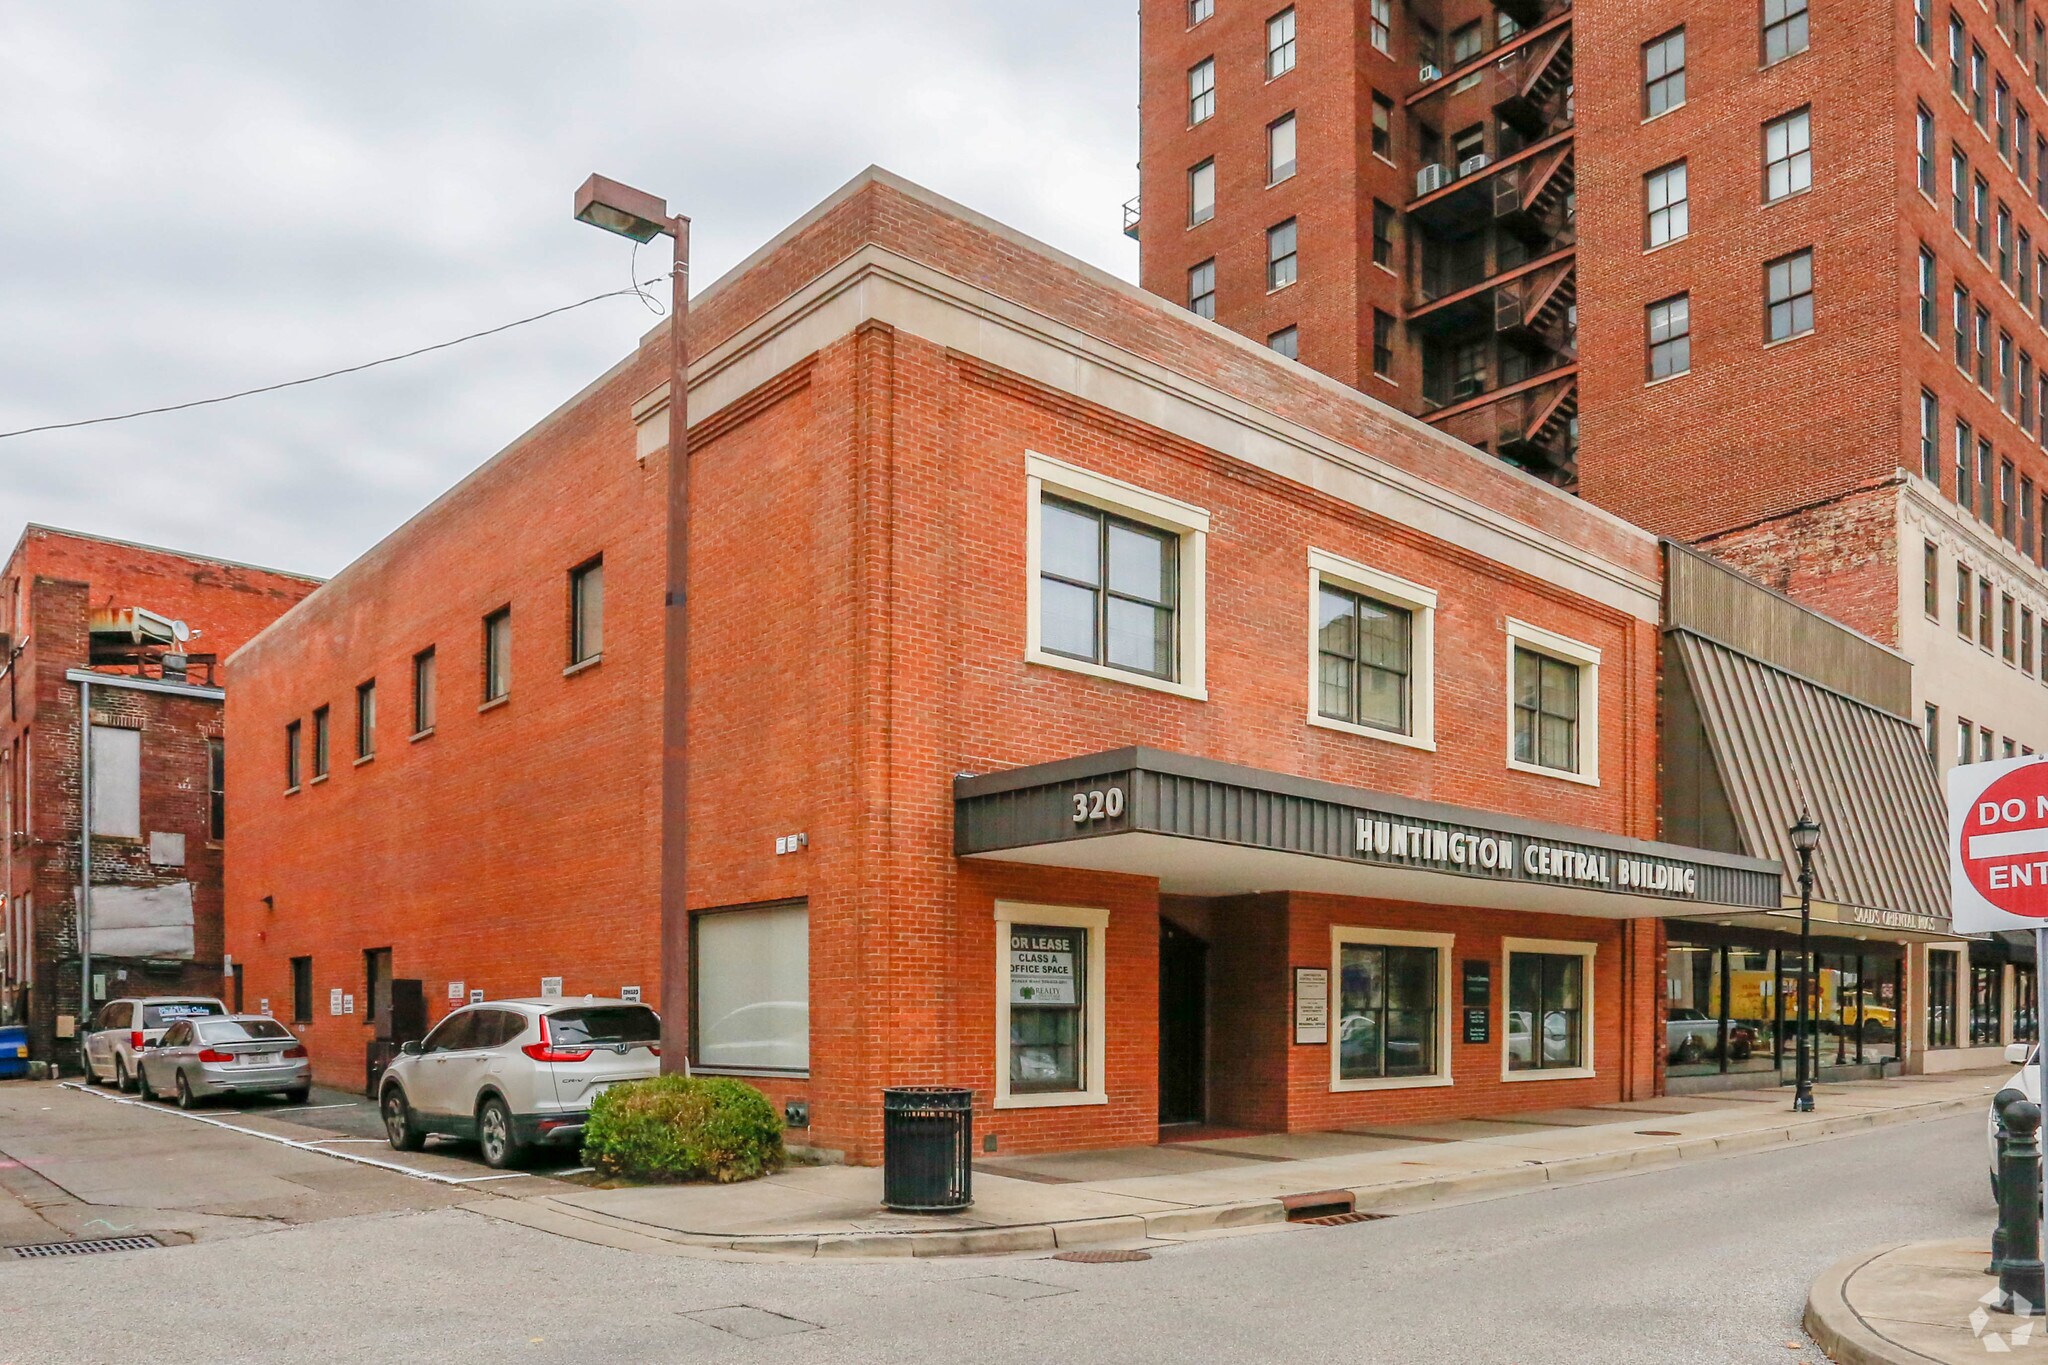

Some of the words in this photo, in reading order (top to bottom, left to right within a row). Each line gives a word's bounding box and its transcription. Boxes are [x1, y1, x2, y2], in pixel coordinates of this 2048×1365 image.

[1072, 787, 1124, 823] 320
[1979, 798, 2027, 826] DO
[1356, 817, 1513, 870] HUNTINGTON
[1523, 844, 1610, 883] CENTRAL
[1617, 858, 1695, 894] BUILDING
[1989, 861, 2048, 890] ENT
[1854, 906, 1880, 924] SAAD'S
[1882, 911, 1917, 929] ORIENTAL
[1011, 936, 1029, 949] OR
[1032, 937, 1070, 951] LEASE
[1010, 965, 1040, 974] OFFICE
[1042, 965, 1069, 974] SPACE
[1018, 953, 1049, 963] CLASS
[1051, 954, 1058, 963] A
[1035, 987, 1061, 995] REALTY
